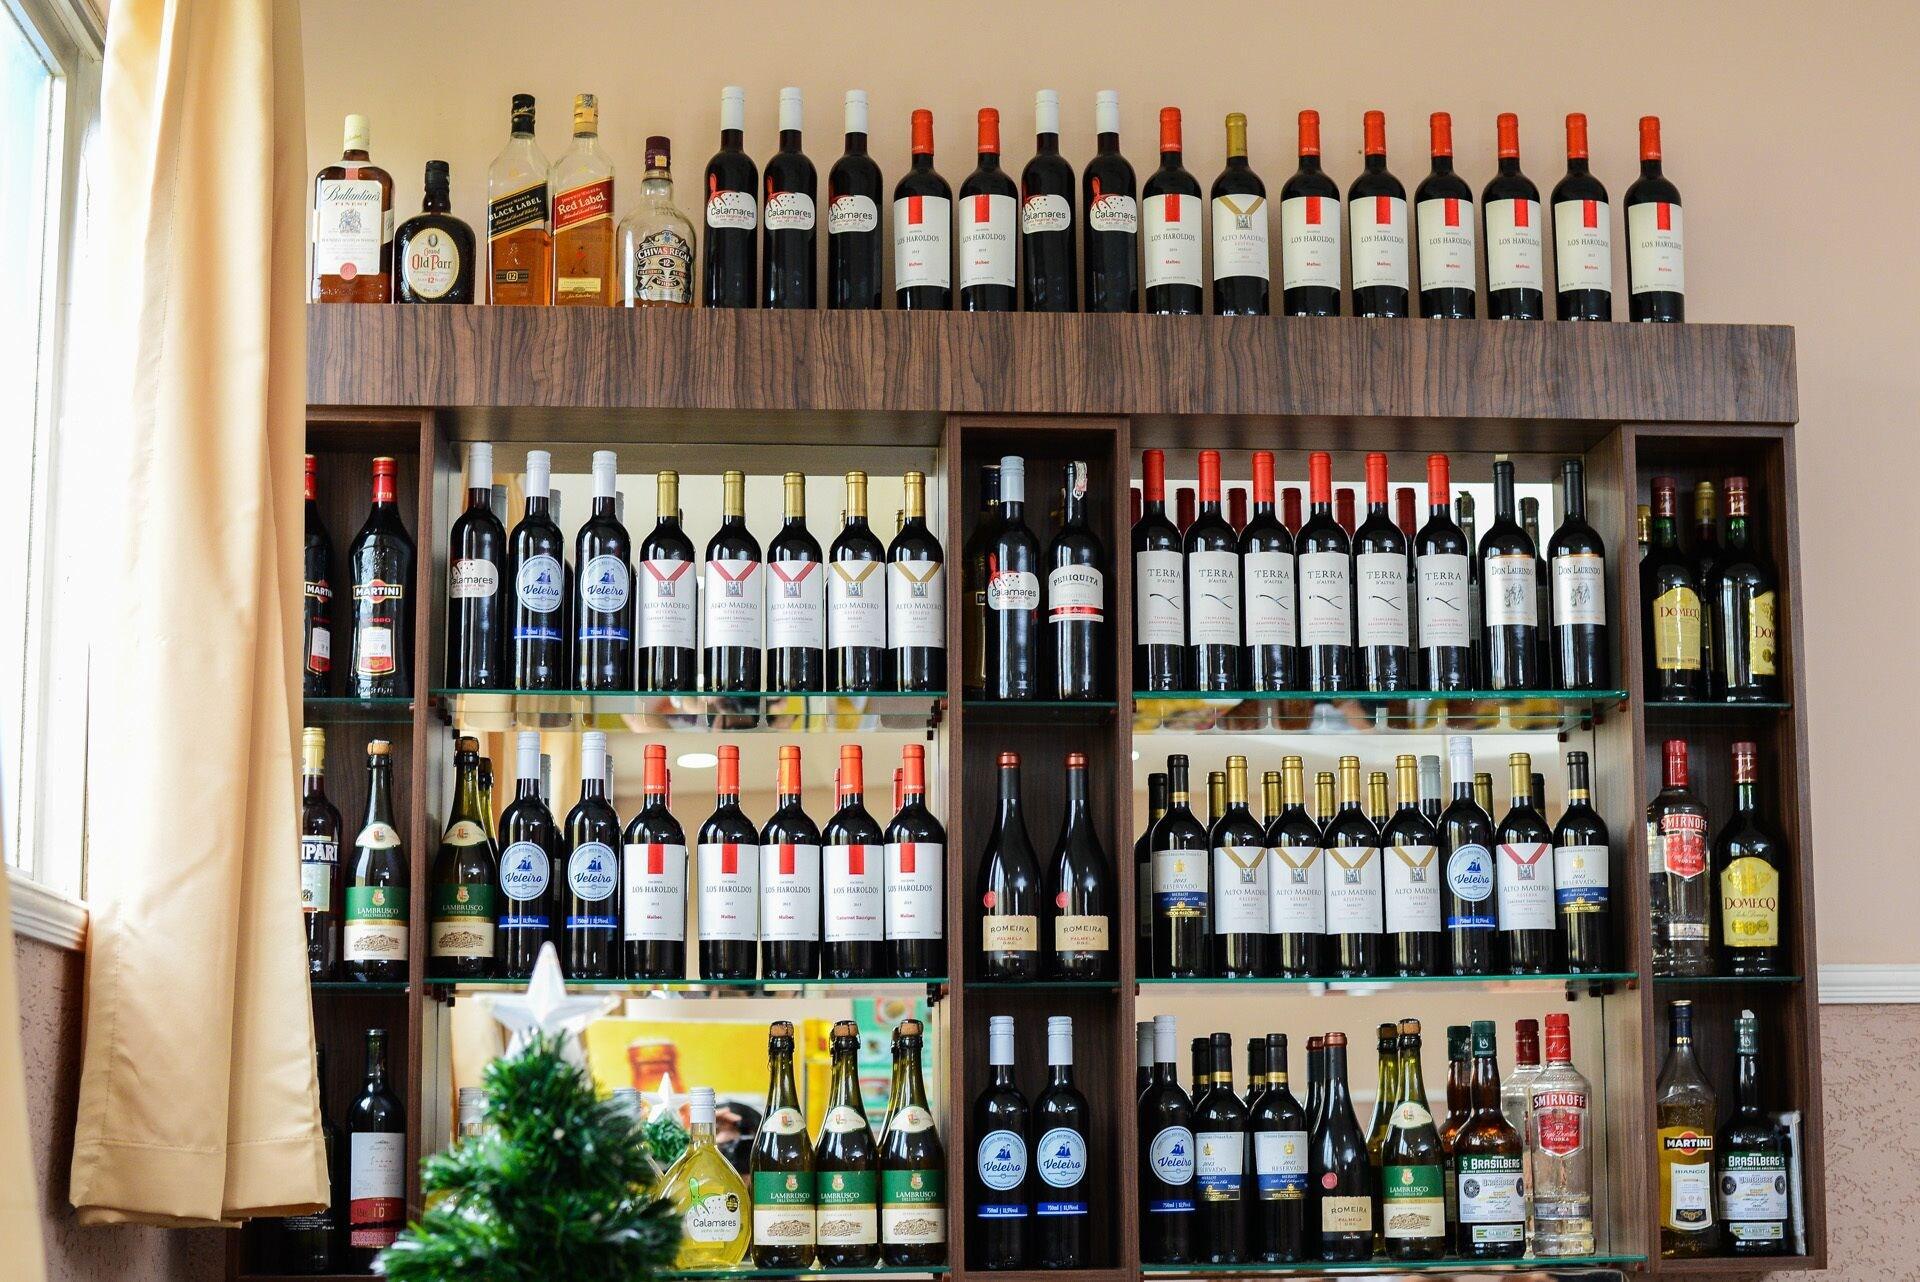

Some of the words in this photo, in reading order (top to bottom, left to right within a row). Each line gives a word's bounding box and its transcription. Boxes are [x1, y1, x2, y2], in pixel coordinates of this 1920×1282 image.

[322, 183, 381, 201] Ballantine's
[556, 201, 578, 216] Red
[578, 191, 607, 209] Label
[488, 204, 515, 222] BLACK
[515, 196, 543, 213] LABEL
[767, 208, 812, 219] Calamares
[829, 210, 873, 223] Calamares
[1023, 209, 1066, 222] Calamares
[1095, 210, 1137, 223] Calamares
[897, 236, 905, 245] LOS
[906, 234, 940, 243] HAROLDOS
[962, 235, 972, 244] LOS
[972, 233, 1007, 242] HAROLDOS
[1151, 234, 1161, 242] LOS
[1162, 232, 1196, 242] HAROLDOS
[1221, 234, 1238, 243] ALTO
[1291, 236, 1302, 244] LOS
[1303, 235, 1335, 245] HAROLDOS
[1360, 236, 1372, 244] LOS
[1373, 235, 1405, 245] HAROLDOS
[1429, 237, 1441, 246] LOS
[1442, 236, 1472, 247] HAROLDOS
[1511, 237, 1540, 247] HAROLDOS
[1580, 238, 1609, 248] HAROLDOS
[1641, 241, 1653, 249] LOS
[1654, 241, 1682, 250] HAROLDOS
[638, 246, 670, 262] CHIVAS
[669, 246, 692, 263] REGAL
[411, 253, 430, 271] Old
[430, 253, 453, 271] Parr
[662, 259, 671, 267] 12
[508, 272, 517, 280] 12
[655, 279, 678, 287] WHISKY
[1147, 568, 1181, 579] TERRA
[1198, 568, 1234, 579] TERRA
[1254, 569, 1290, 580] TERRA
[1307, 570, 1344, 579] TERRA
[1366, 570, 1402, 580] TERRA
[1491, 566, 1506, 576] DON
[1507, 564, 1535, 576] LAURINDO
[1558, 565, 1572, 576] DON
[1573, 564, 1601, 576] LAURINDO
[1425, 571, 1462, 581] TERRA
[355, 586, 400, 597] MARTINI
[523, 584, 560, 597] Veleiro
[587, 583, 624, 597] Veleiro
[991, 587, 1037, 597] Calamares
[661, 601, 690, 610] MADERO
[729, 601, 758, 610] MADERO
[787, 602, 817, 611] MADERO
[849, 602, 879, 610] MADERO
[1660, 606, 1700, 622] DOMECQ
[1660, 815, 1708, 832] SMIRNOFF
[504, 871, 544, 883] Veleiro
[573, 872, 613, 884] Veleiro
[1454, 874, 1490, 885] Veleiro
[632, 886, 643, 894] LOS
[644, 885, 679, 894] HAROLDOS
[718, 885, 752, 894] HAROLDOS
[765, 886, 776, 894] LOS
[776, 886, 811, 894] HAROLDOS
[833, 887, 845, 895] LOS
[846, 886, 880, 895] HAROLDOS
[887, 885, 898, 893] LOS
[898, 884, 933, 893] HAROLDOS
[1275, 888, 1293, 896] ALTO
[1295, 888, 1322, 896] MADERO
[1330, 889, 1346, 897] ALTO
[1347, 888, 1377, 896] MADERO
[1503, 884, 1520, 893] ALTO
[1521, 884, 1550, 892] MADERO
[442, 904, 484, 913] LAMBRUSCO
[1724, 896, 1776, 913] DOMECQ
[357, 907, 399, 915] LAMBRUSCO
[990, 925, 1030, 934] ROMEIRA
[1063, 925, 1103, 934] ROMEIRA
[1533, 1093, 1584, 1109] SMIRNOFF
[1666, 1137, 1711, 1148] MARTINI
[1043, 1158, 1082, 1170] Veleiro
[1157, 1156, 1192, 1168] Veleiro
[1471, 1158, 1521, 1170] BRASILBERG
[1728, 1155, 1780, 1167] BRASILBERG
[983, 1161, 1021, 1173] Veleiro
[820, 1191, 860, 1199] LAMBRUSCO
[895, 1190, 937, 1199] LAMBRUSCO
[1389, 1186, 1429, 1194] LAMBRUSCO
[770, 1191, 810, 1200] LAMBRUSCO
[1331, 1205, 1367, 1214] ROMEIRA
[693, 1218, 737, 1228] Calamares
